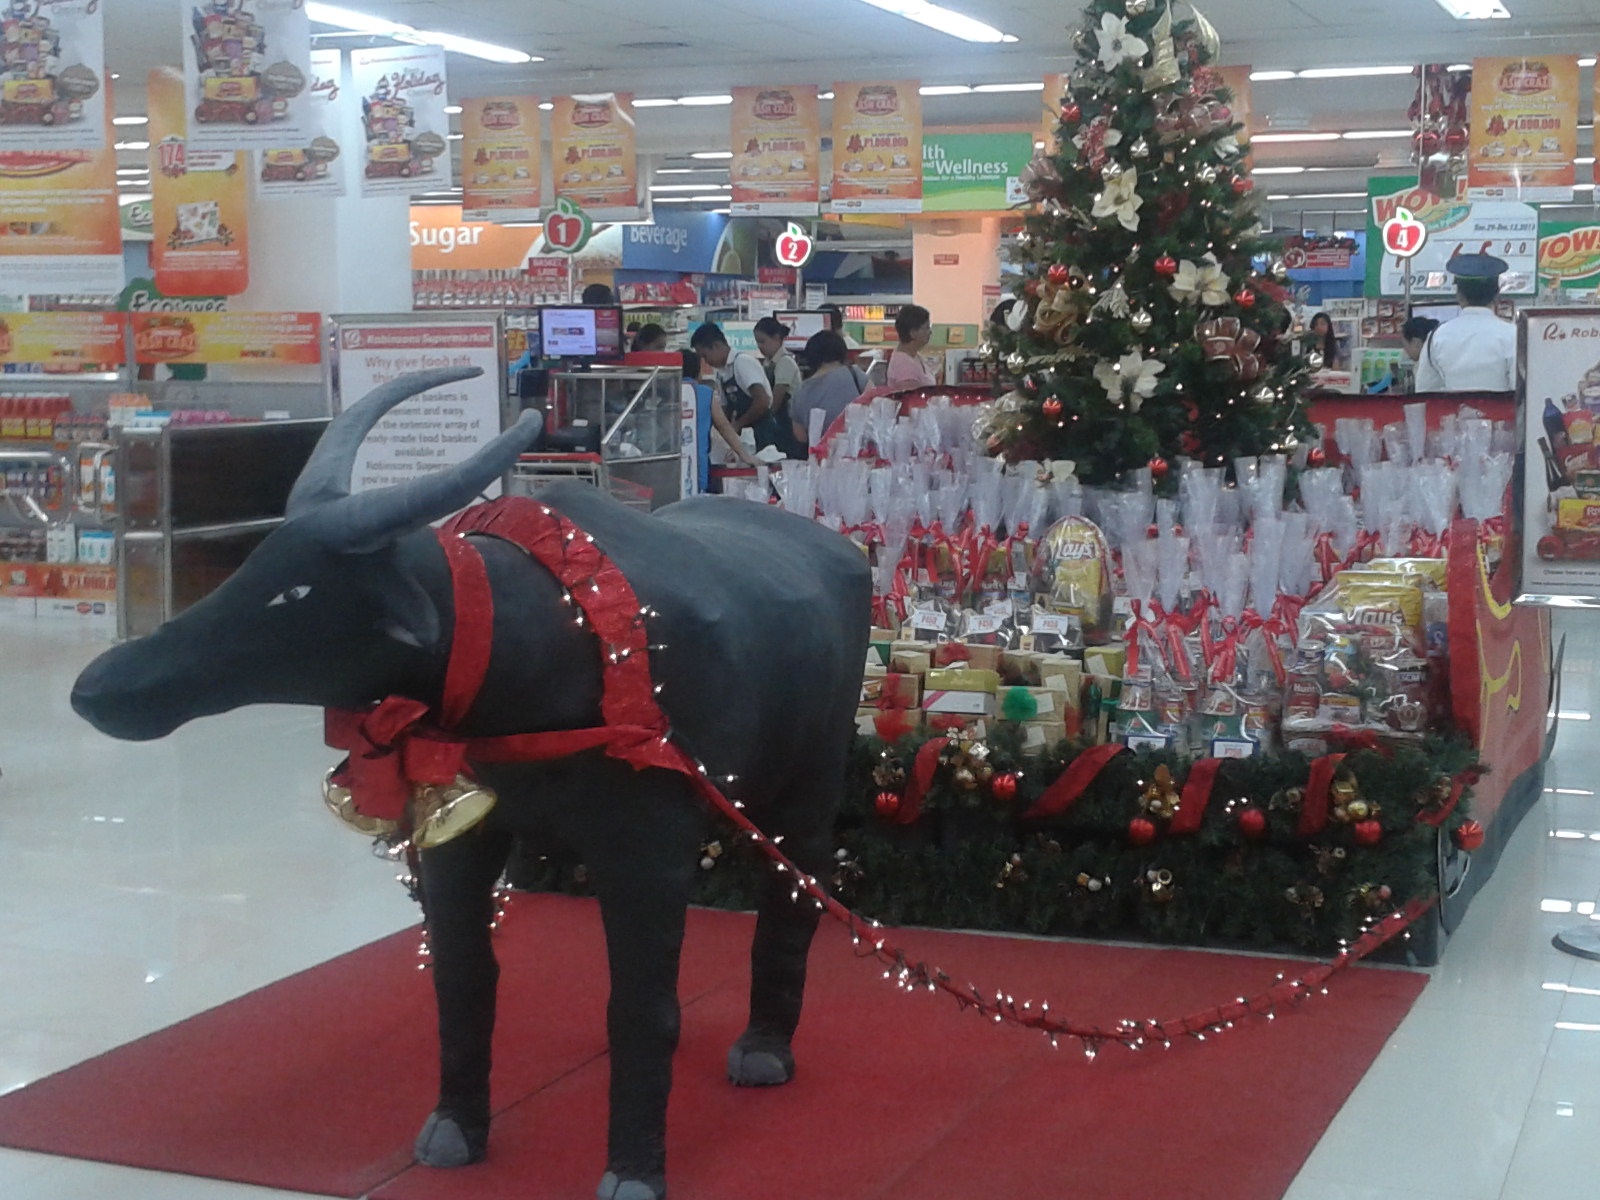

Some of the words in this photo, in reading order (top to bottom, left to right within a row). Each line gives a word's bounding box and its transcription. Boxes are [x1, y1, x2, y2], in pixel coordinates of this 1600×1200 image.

[922, 144, 945, 160] lth
[922, 160, 935, 168] nd
[935, 158, 1008, 174] Wellness
[409, 222, 484, 253] Sugar
[556, 222, 568, 243] 1
[630, 225, 688, 254] Beverage
[1396, 230, 1409, 249] 4
[788, 241, 799, 259] 2
[366, 334, 421, 344] Robinsons
[422, 332, 491, 345] Supermarket
[1571, 327, 1600, 338] Rob
[365, 356, 392, 369] Why
[395, 356, 418, 370] give
[421, 355, 449, 369] food
[422, 392, 456, 402] baskets
[388, 407, 421, 416] venient
[423, 406, 440, 415] and
[442, 408, 464, 417] easy
[444, 422, 468, 431] array
[470, 420, 480, 429] of
[419, 433, 440, 443] food
[441, 433, 478, 443] baskets
[394, 448, 434, 457] available
[366, 461, 413, 471] Robinsons
